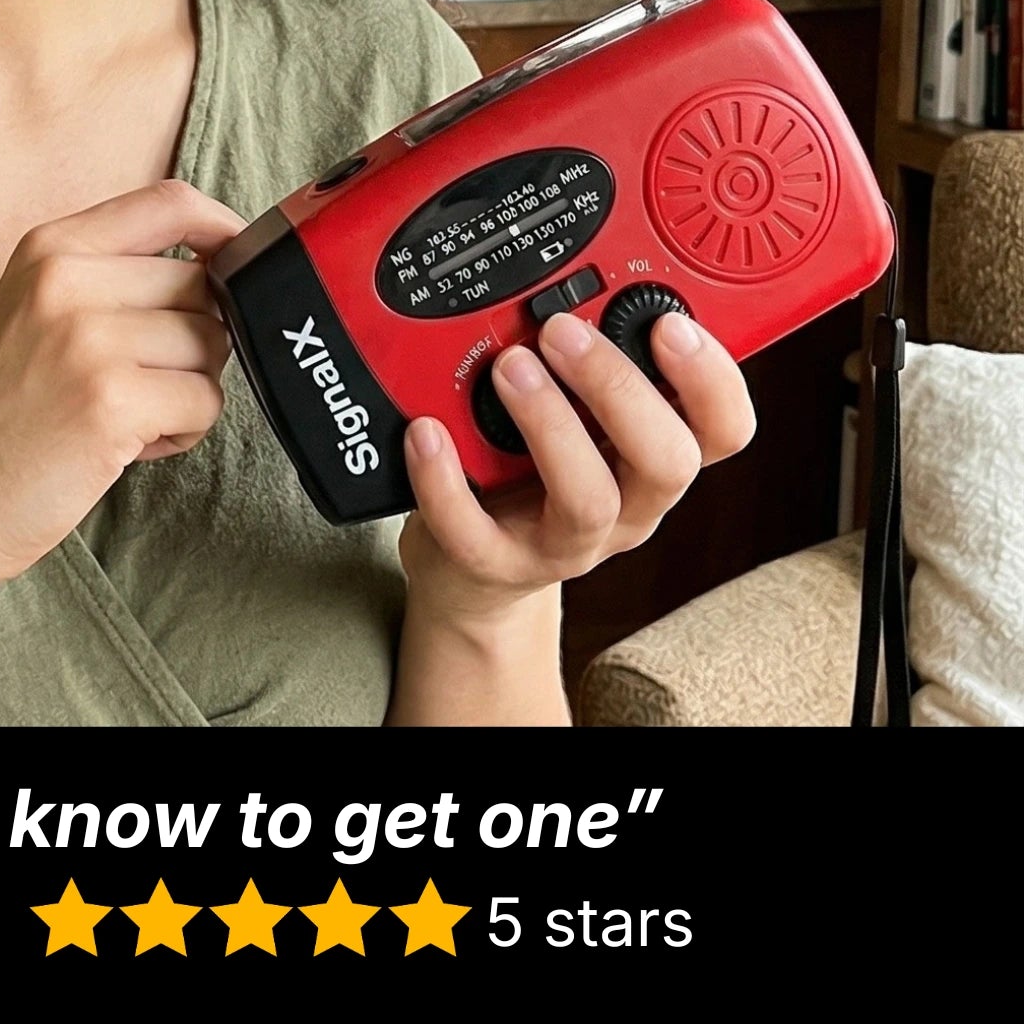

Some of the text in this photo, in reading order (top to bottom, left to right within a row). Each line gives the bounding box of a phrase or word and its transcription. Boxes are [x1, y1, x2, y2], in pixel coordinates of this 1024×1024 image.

[390, 247, 413, 267] NG
[559, 163, 590, 185] MHz
[409, 285, 431, 306] AM
[455, 267, 472, 283] 70
[474, 258, 490, 273] 90
[490, 245, 512, 264] 110
[512, 234, 534, 252] 130
[554, 211, 577, 229] 170
[573, 191, 600, 210] KHz
[441, 241, 456, 255] 90
[480, 219, 495, 234] 96
[539, 183, 561, 201] 108
[462, 280, 490, 301] TUN
[627, 260, 652, 273] VOL
[282, 315, 380, 475] SignalX
